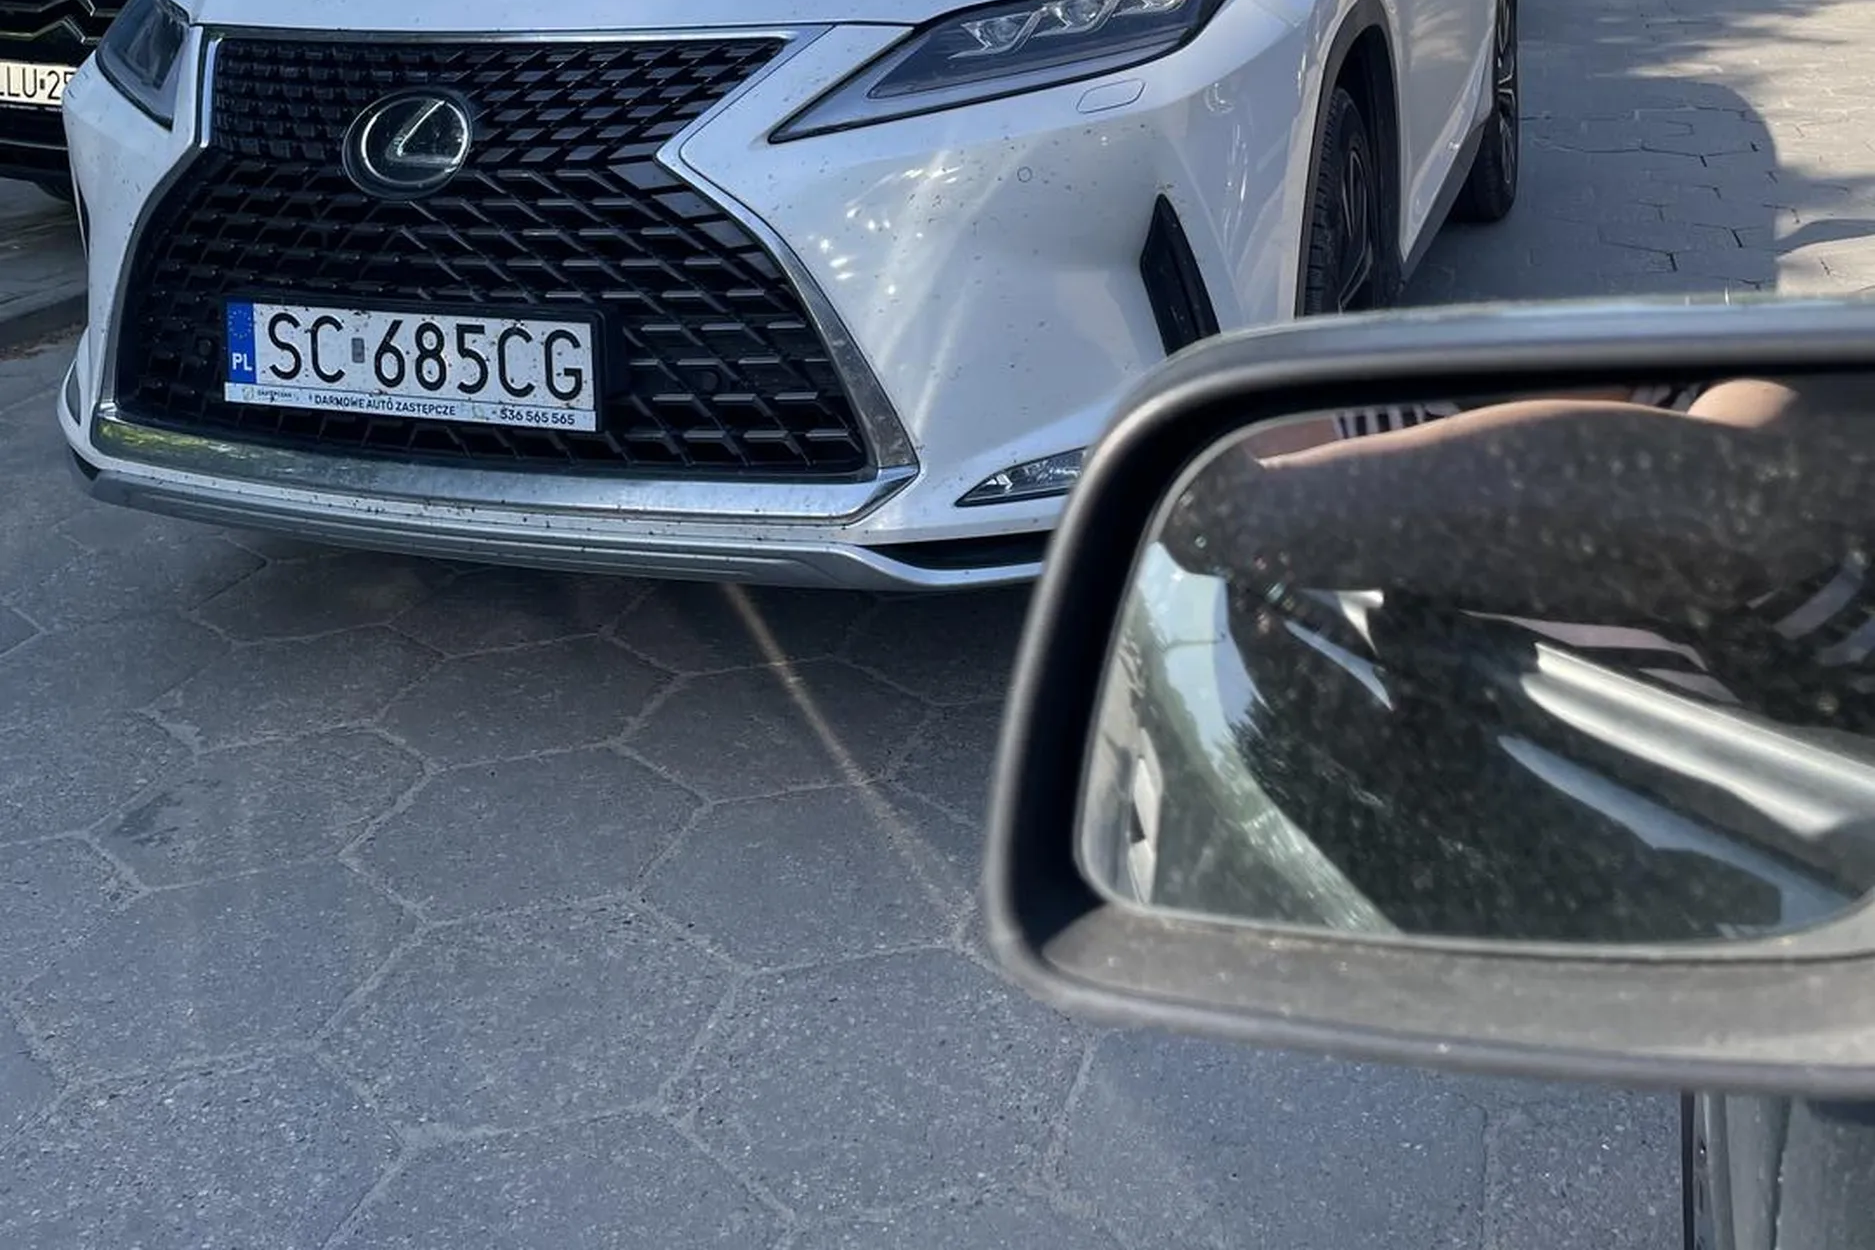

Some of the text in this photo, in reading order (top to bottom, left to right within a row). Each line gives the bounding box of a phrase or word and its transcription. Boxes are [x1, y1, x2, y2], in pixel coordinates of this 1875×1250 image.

[232, 353, 253, 371] PL
[268, 312, 583, 401] SC 685CG
[314, 395, 366, 409] DARMOWE
[395, 401, 456, 417] ZASTĘPCZE
[500, 408, 524, 421] 536
[526, 411, 550, 424] 565
[551, 414, 575, 426] 565
